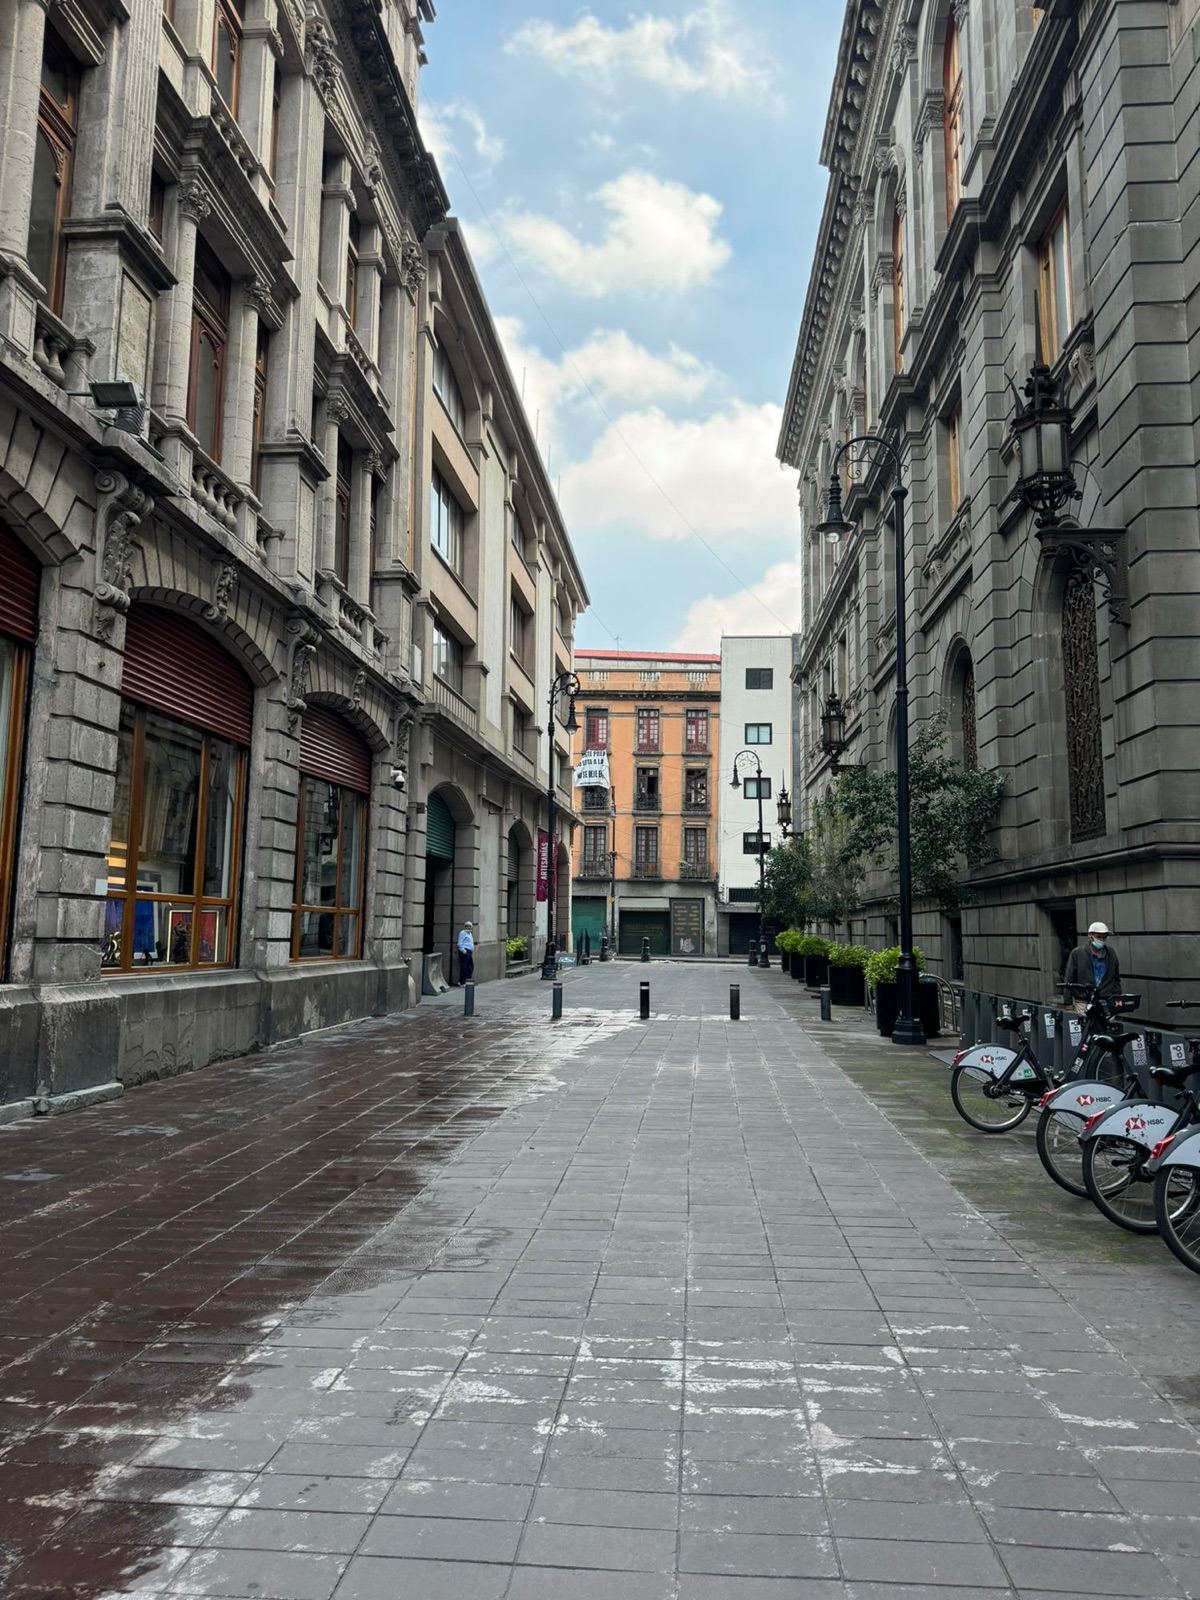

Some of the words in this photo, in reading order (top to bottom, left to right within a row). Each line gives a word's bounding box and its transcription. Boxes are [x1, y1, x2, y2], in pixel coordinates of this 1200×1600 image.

[583, 770, 588, 778] SE
[540, 842, 549, 880] ARTESANÍAS
[1147, 1118, 1164, 1126] HSBC
